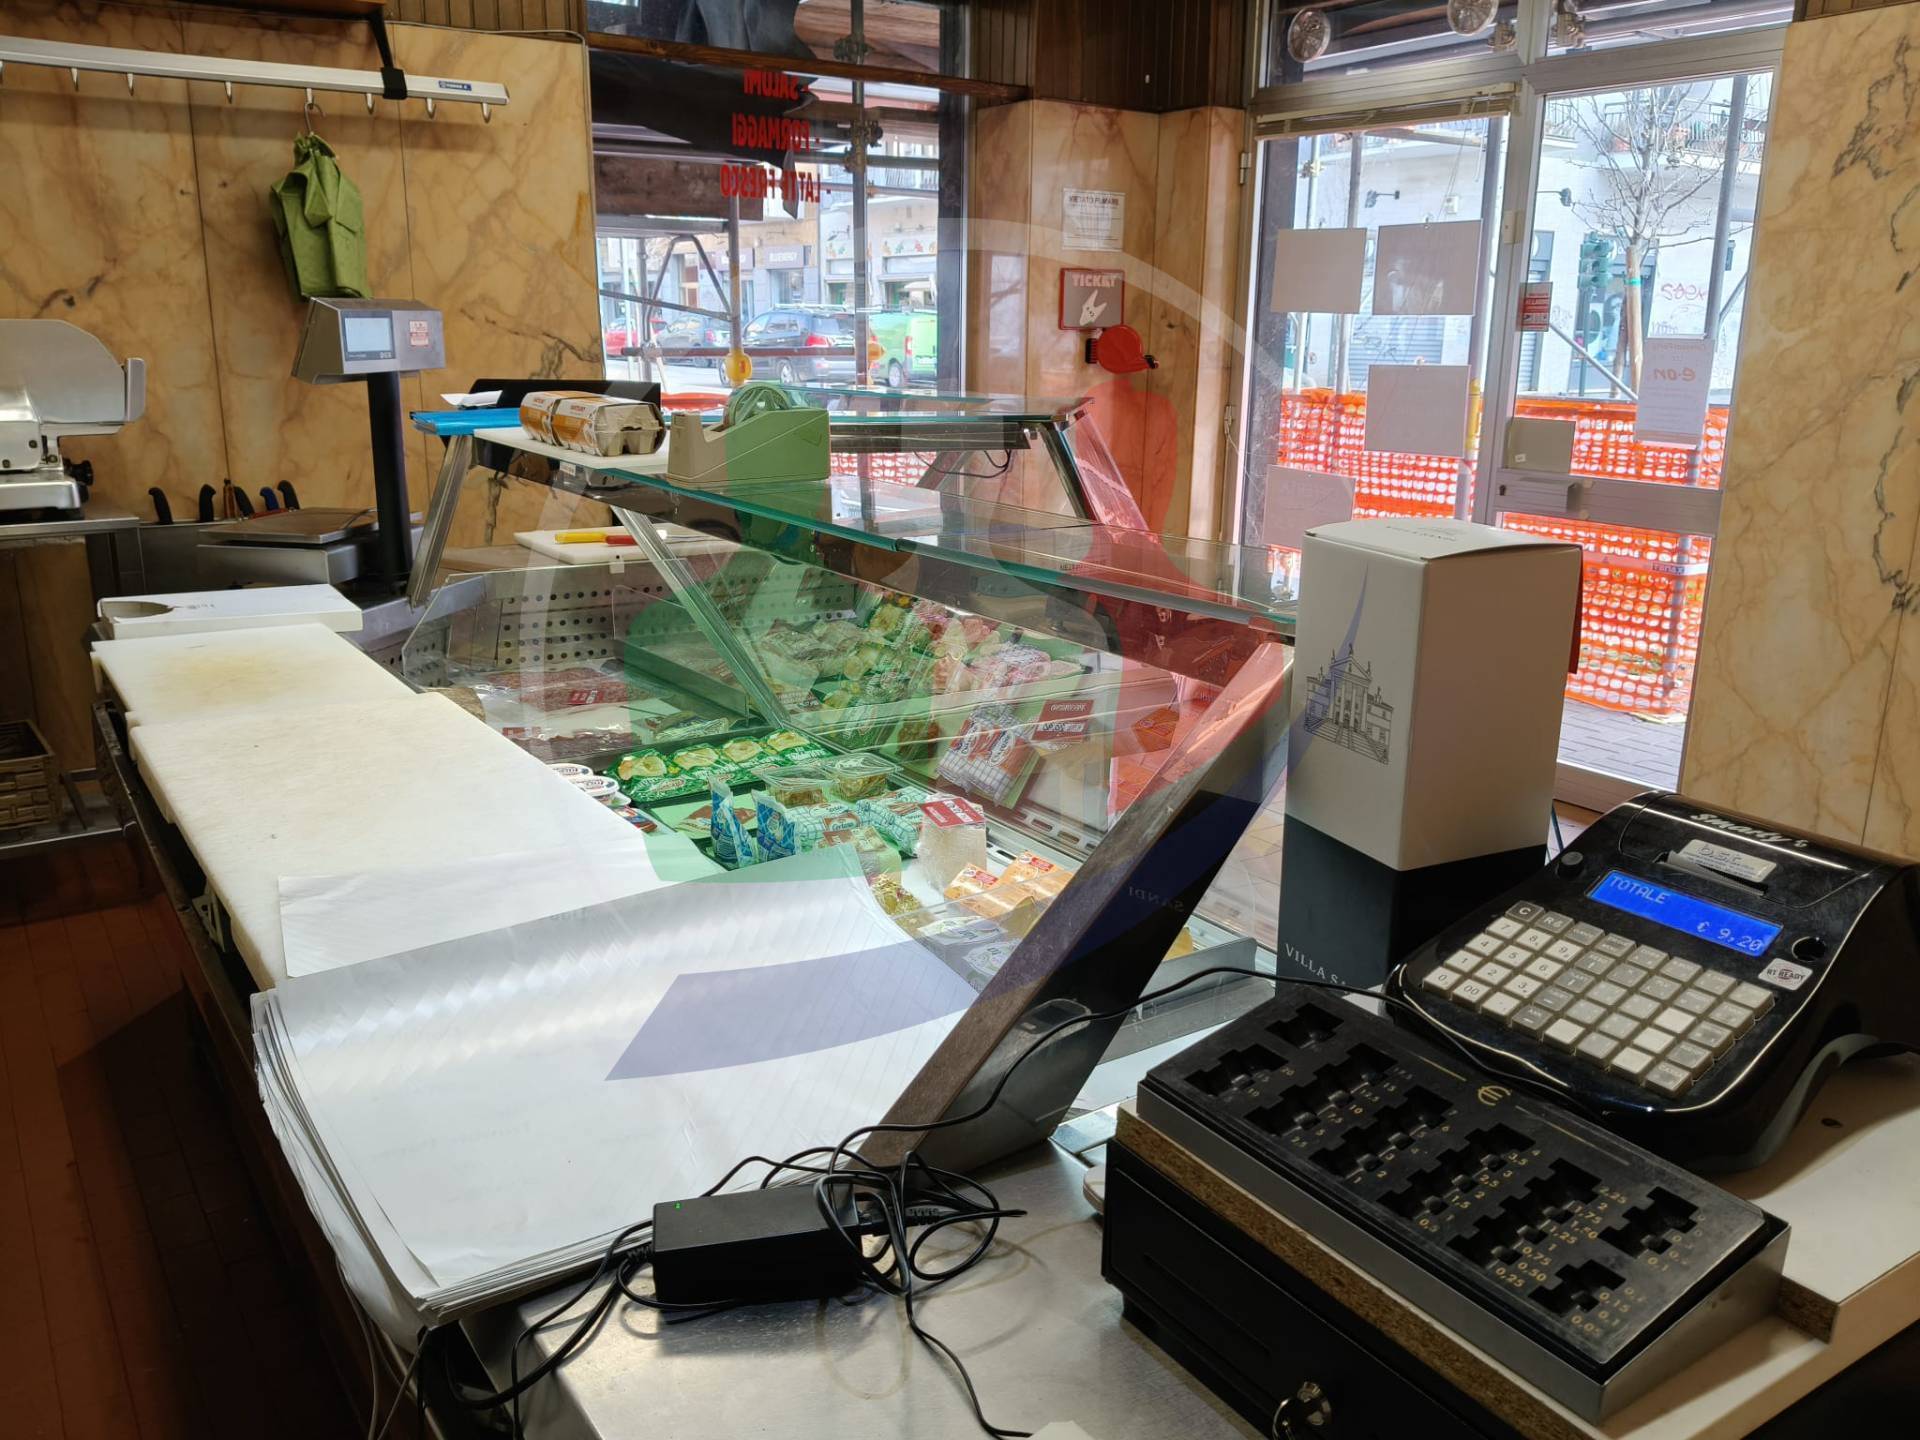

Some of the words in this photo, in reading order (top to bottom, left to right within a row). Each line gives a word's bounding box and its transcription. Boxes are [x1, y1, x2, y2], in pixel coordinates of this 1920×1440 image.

[1071, 273, 1117, 287] TICKET
[1609, 875, 1671, 905] TOTALE
[1519, 906, 1532, 915] C
[1718, 928, 1765, 951] 9,20
[1285, 943, 1326, 980] VILLA
[1463, 985, 1481, 996] 00
[1349, 1104, 1363, 1114] 10
[1496, 1267, 1525, 1288] 0,25
